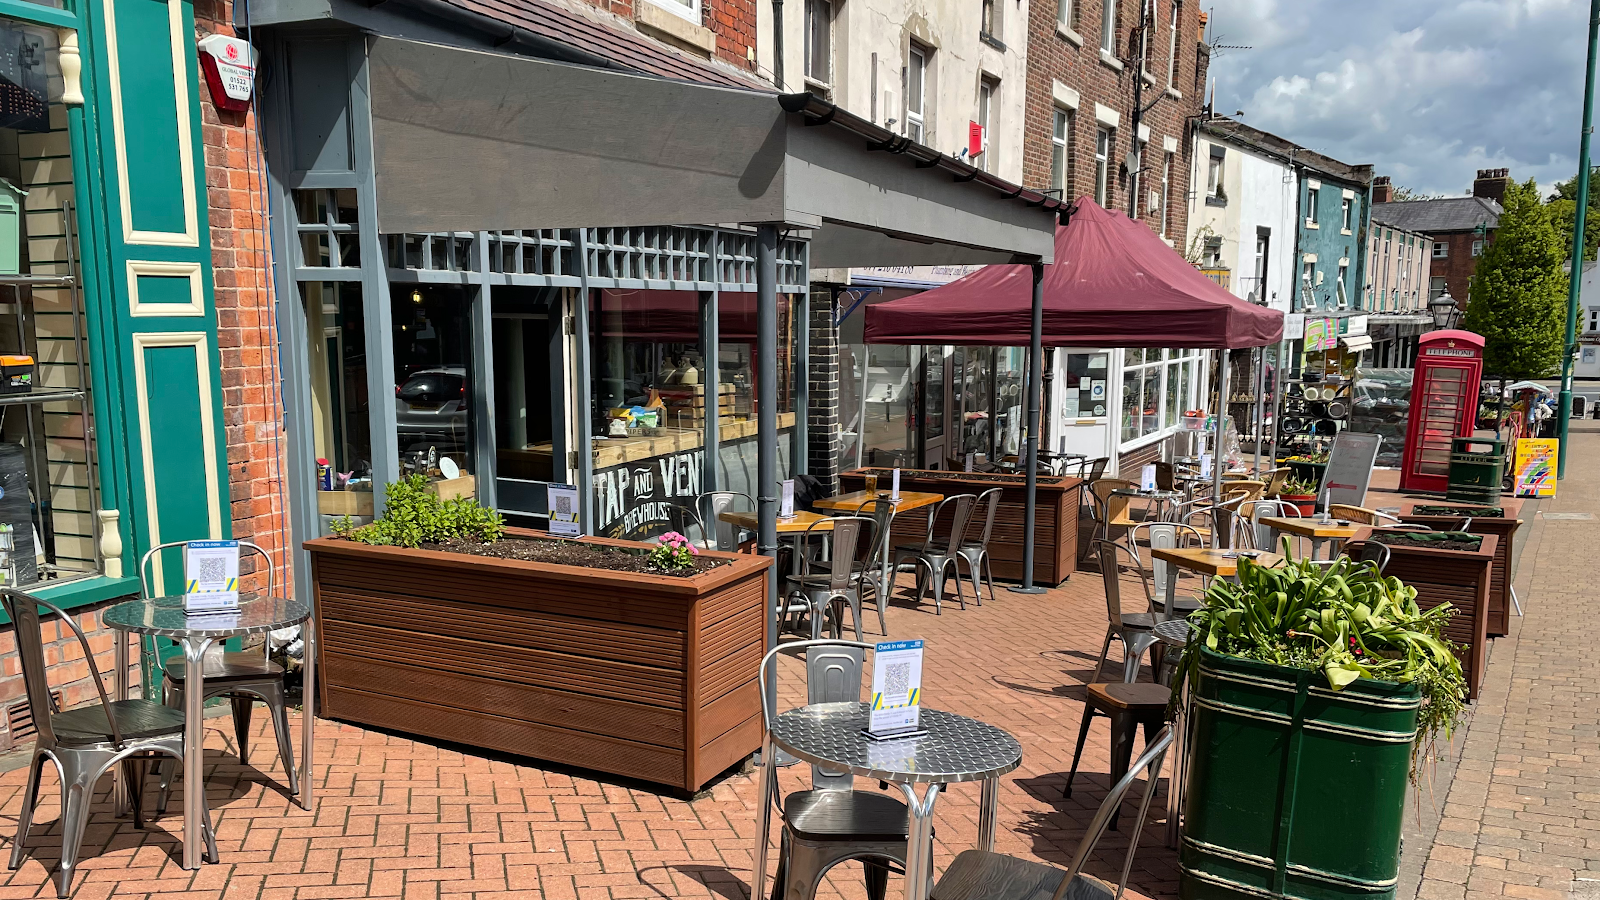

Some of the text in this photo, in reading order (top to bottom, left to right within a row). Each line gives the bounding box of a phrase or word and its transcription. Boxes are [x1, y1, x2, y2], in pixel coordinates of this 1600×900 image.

[230, 76, 246, 85] 01522
[1428, 349, 1474, 357] TELEPHONE
[592, 467, 630, 530] TAP
[634, 472, 653, 497] AND
[624, 501, 672, 535] BREWHOUSE
